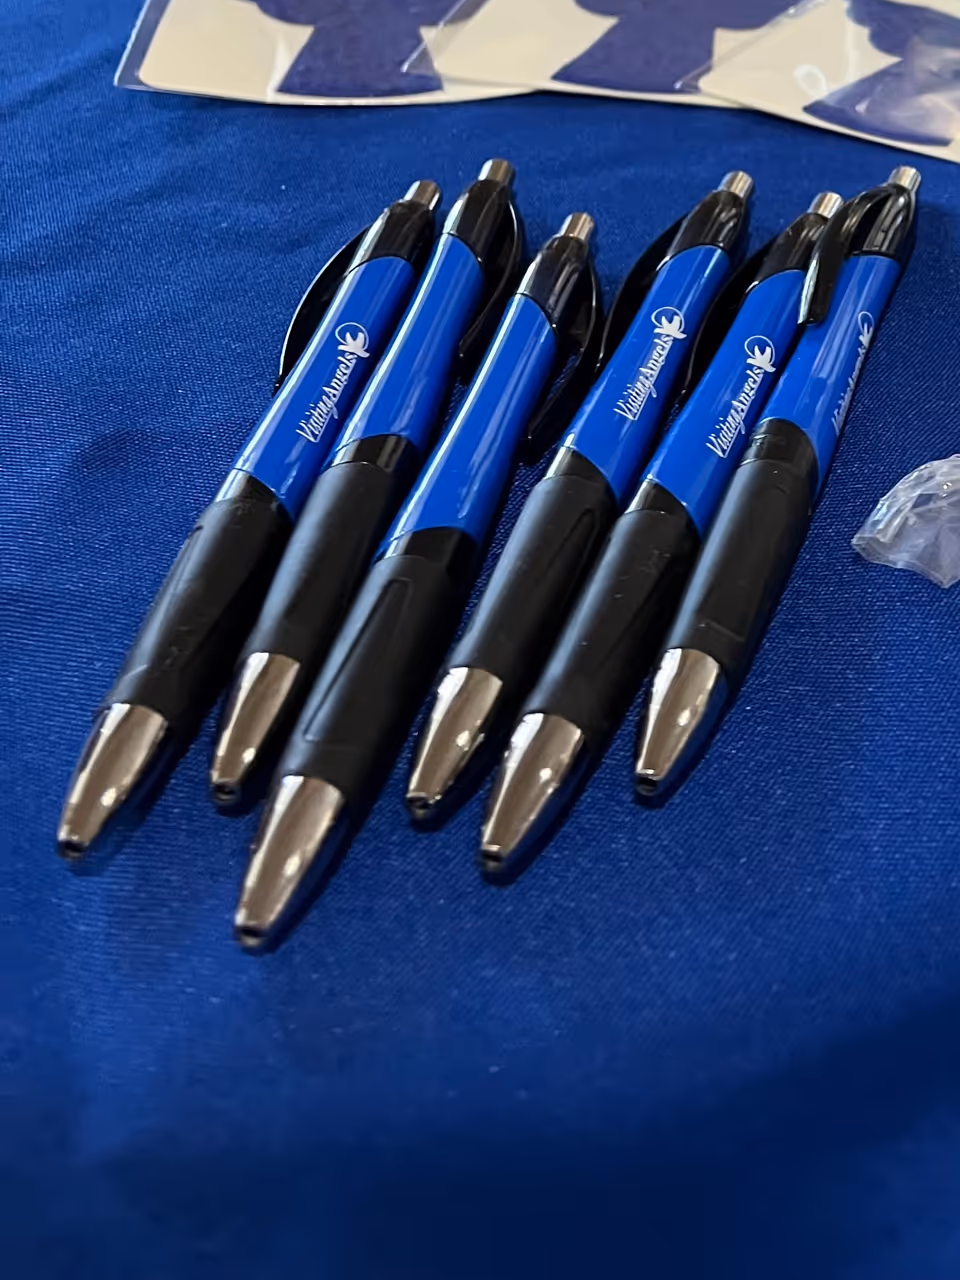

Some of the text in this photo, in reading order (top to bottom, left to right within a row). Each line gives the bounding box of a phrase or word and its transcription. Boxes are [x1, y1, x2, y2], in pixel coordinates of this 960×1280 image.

[296, 352, 358, 443] Visiting Angels
[613, 334, 674, 421] Visiting Angels
[705, 366, 764, 458] Visiting Angels
